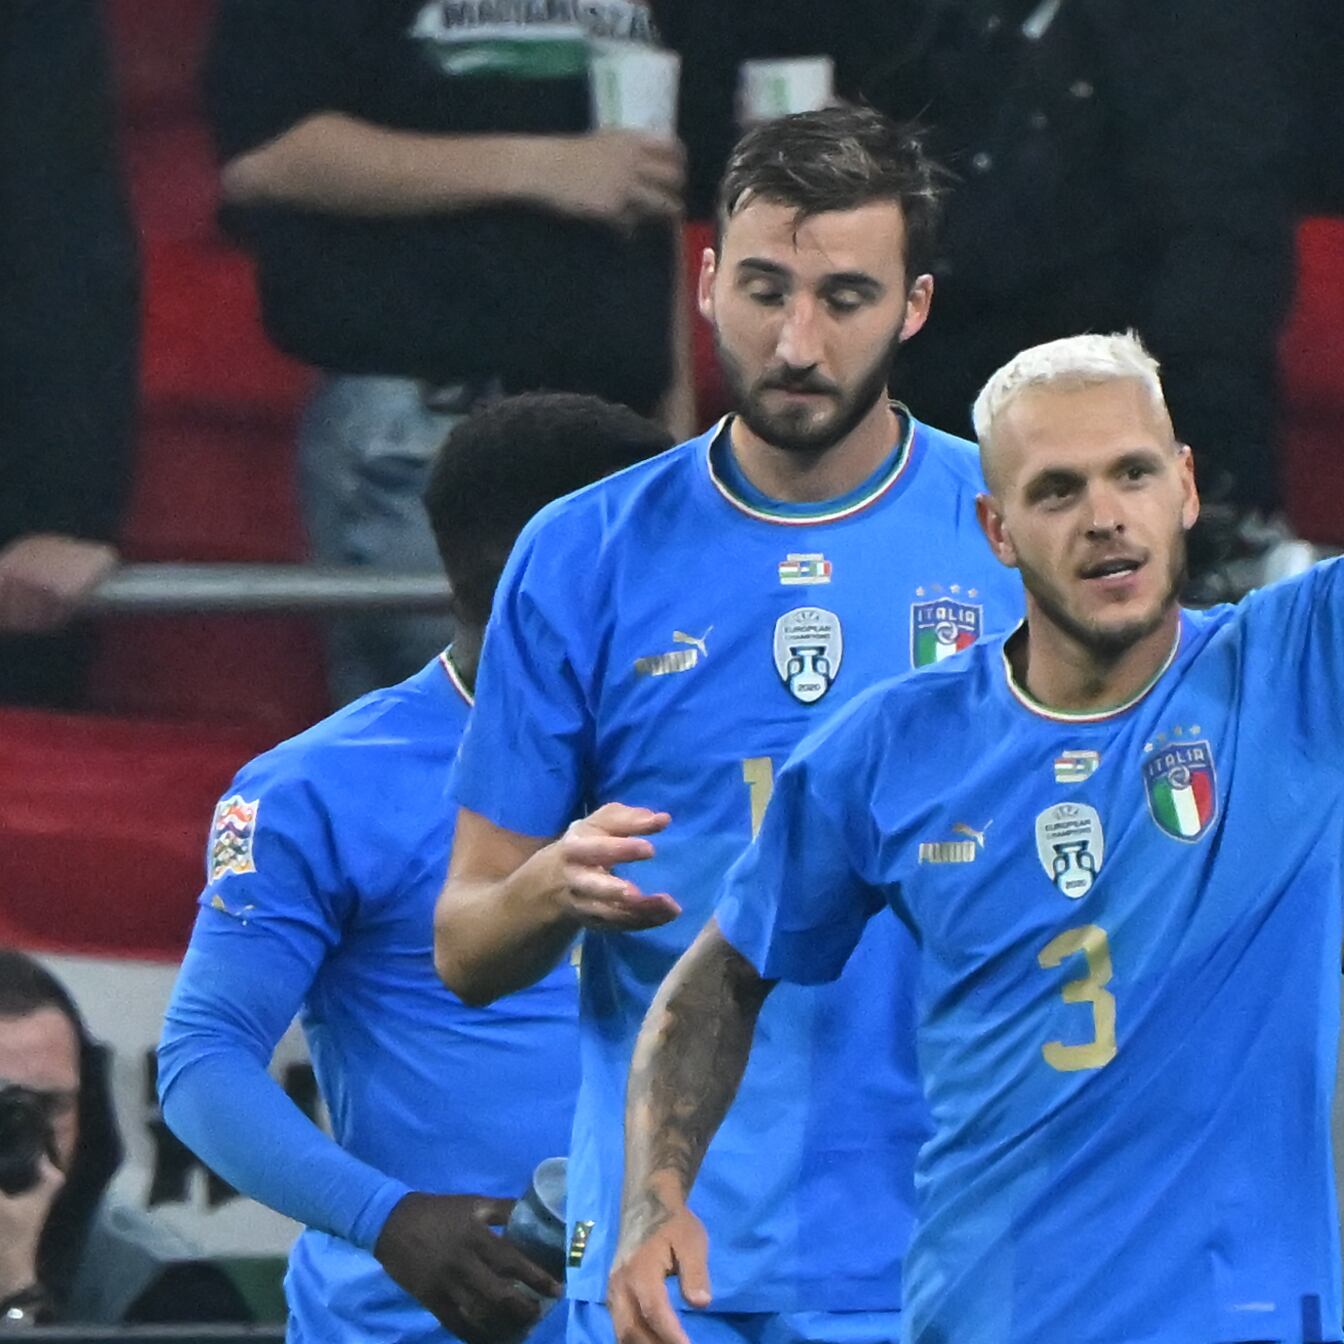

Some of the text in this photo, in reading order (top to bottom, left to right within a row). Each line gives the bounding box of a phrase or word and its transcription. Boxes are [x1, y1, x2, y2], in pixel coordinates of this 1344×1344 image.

[917, 606, 976, 624] ITALIA
[1148, 748, 1205, 777] ITALIA
[1037, 923, 1118, 1073] 3
